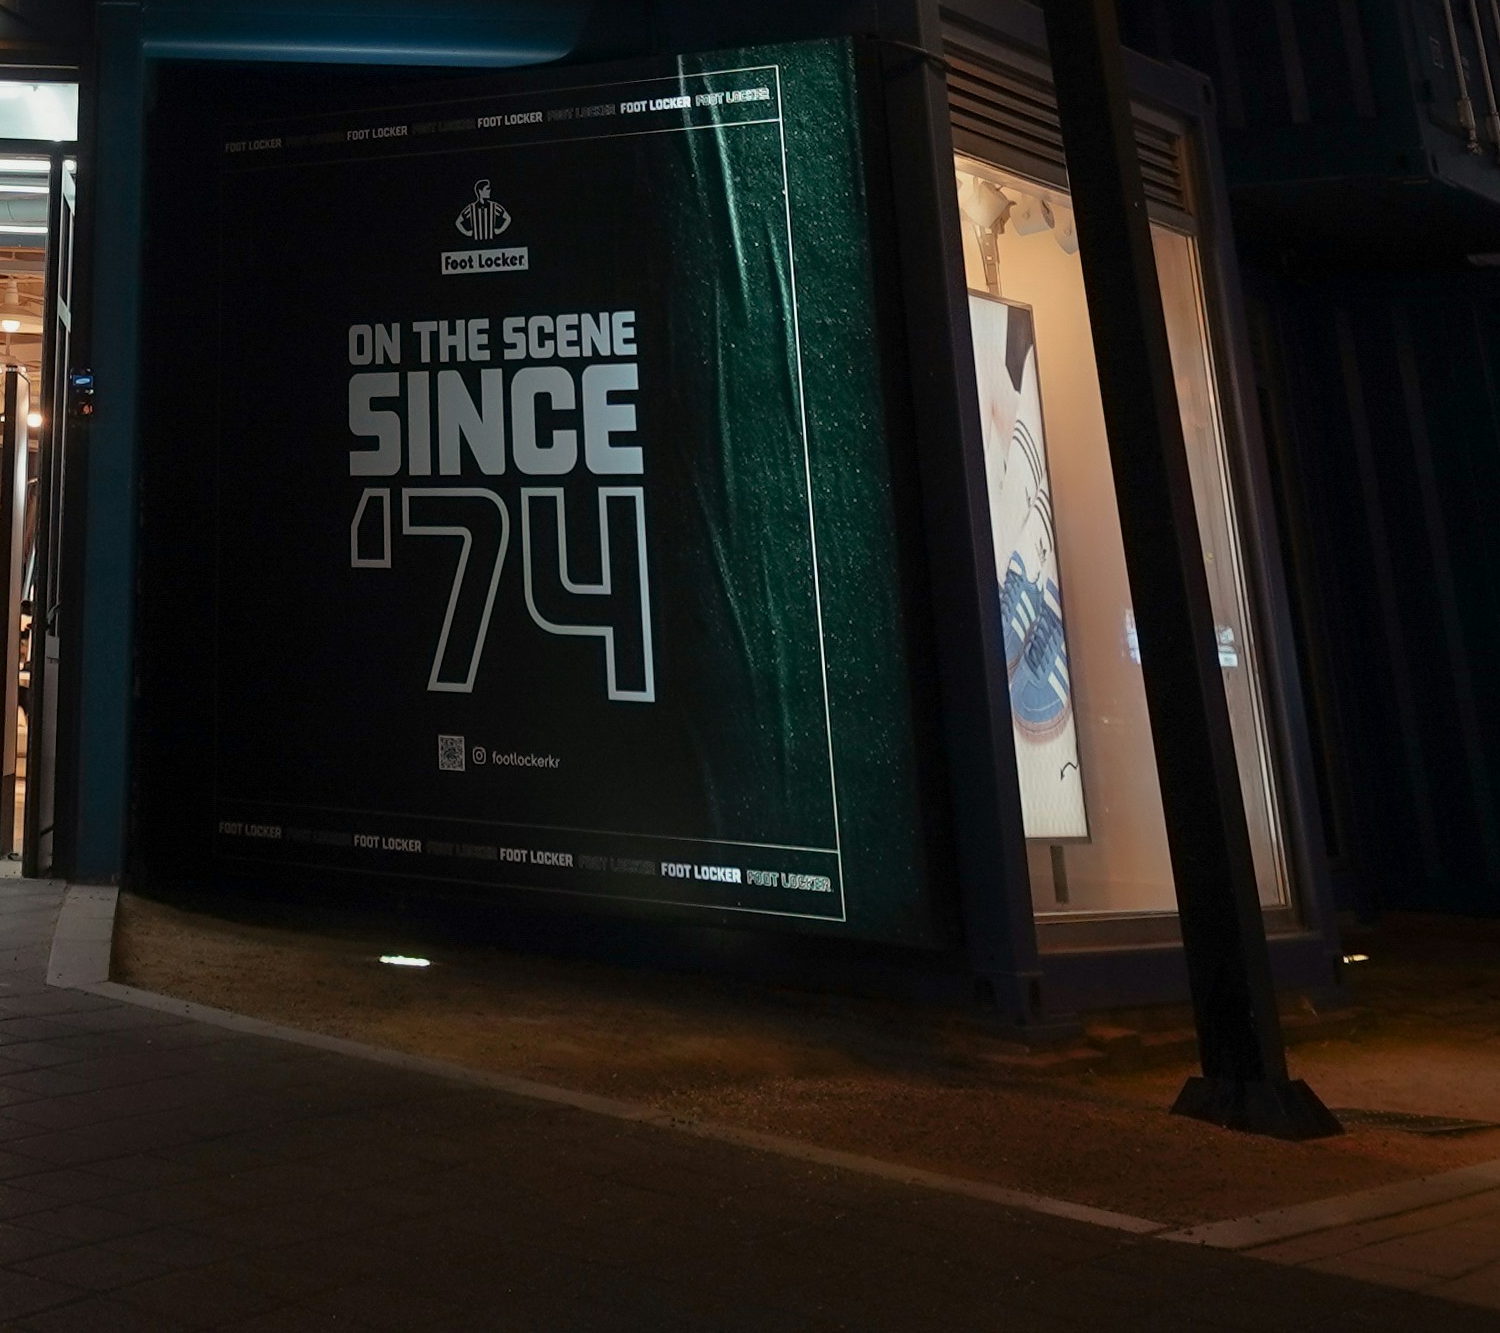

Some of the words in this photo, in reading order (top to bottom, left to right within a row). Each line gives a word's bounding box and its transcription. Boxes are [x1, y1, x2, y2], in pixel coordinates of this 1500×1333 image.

[347, 129, 371, 141] FOOT
[372, 125, 408, 139] LOCKER
[477, 115, 502, 129] FOOT
[503, 111, 543, 128] LOCKER
[620, 101, 647, 114] FOOT
[648, 96, 691, 112] LOCKER
[445, 255, 473, 270] Foot
[479, 252, 524, 268] Locker
[347, 322, 401, 367] ON
[412, 317, 490, 364] THE
[501, 309, 639, 358] SCENE
[347, 362, 644, 478] SINCE
[492, 750, 561, 769] footlockerkr
[353, 833, 381, 850] FOOT
[382, 836, 422, 854] LOCKER
[500, 847, 529, 864] FOOT
[530, 850, 575, 869] LOCKER
[661, 861, 693, 880] FOOT
[694, 865, 742, 885] LOCKER
